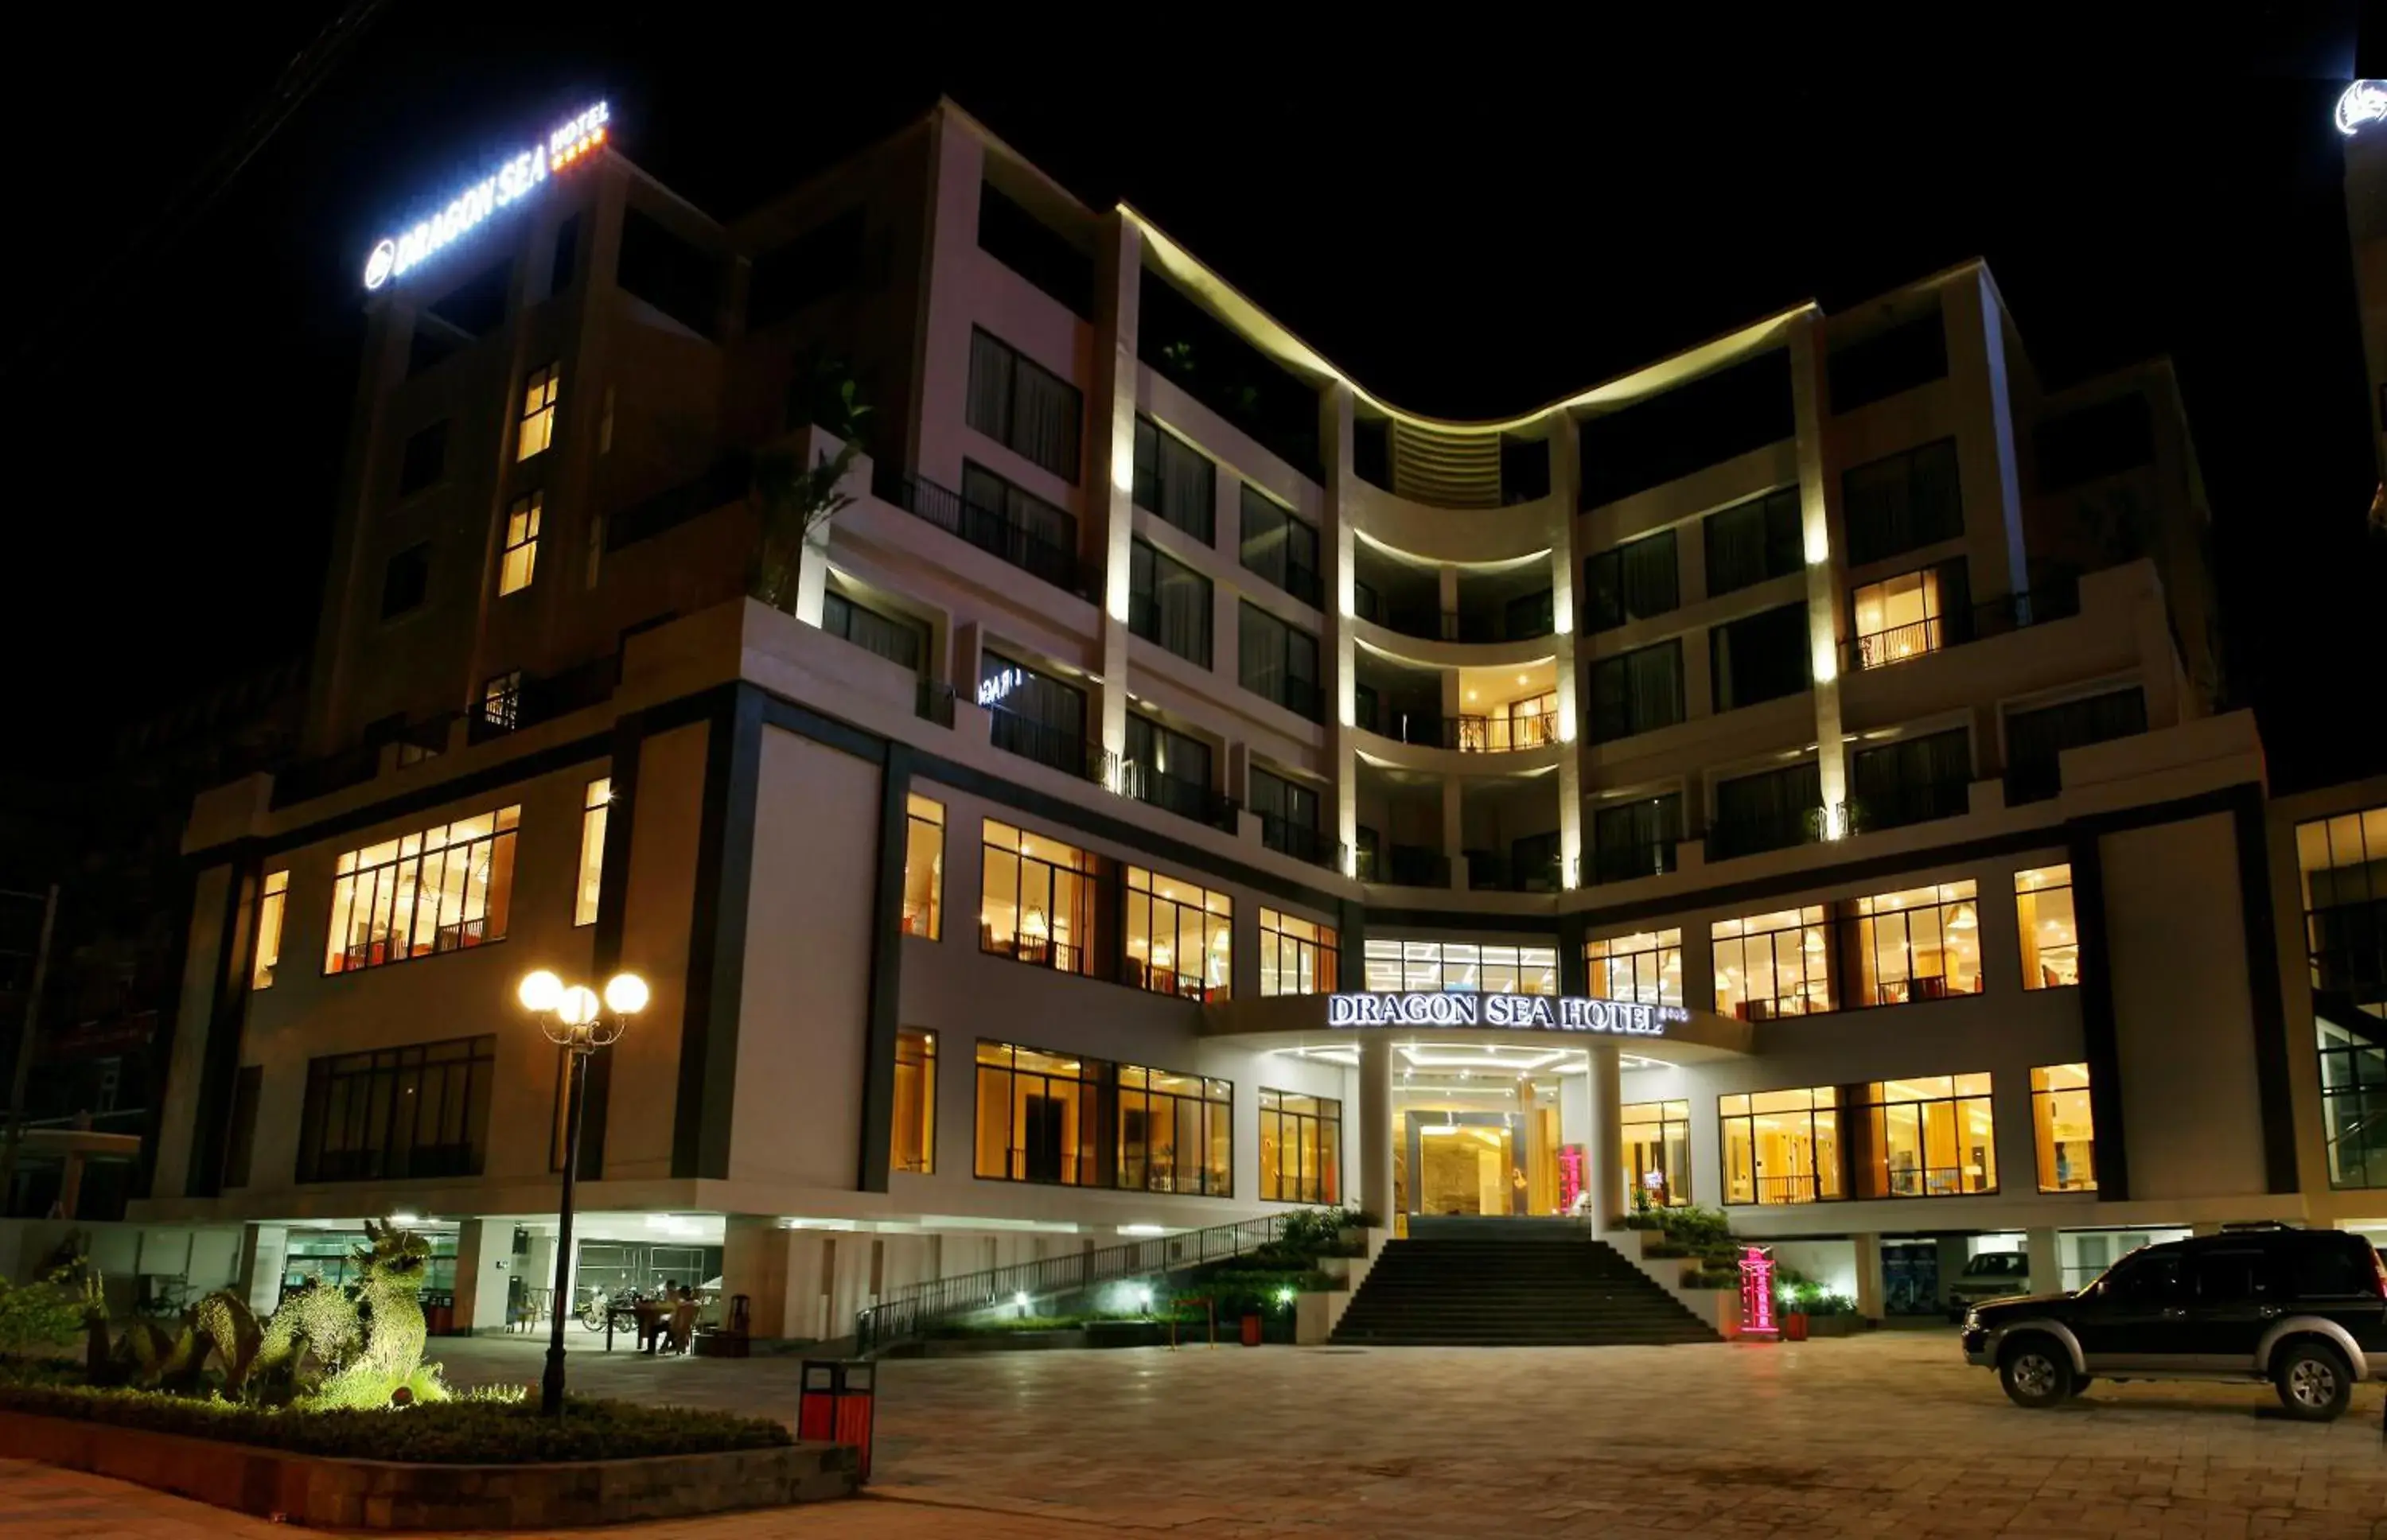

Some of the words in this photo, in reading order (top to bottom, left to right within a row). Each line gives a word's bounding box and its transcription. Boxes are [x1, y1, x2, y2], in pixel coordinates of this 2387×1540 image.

[395, 177, 496, 276] DRAGON
[496, 144, 547, 207] SEA
[551, 101, 609, 154] HOTEL
[1329, 994, 1478, 1025] DRAGON
[1486, 995, 1556, 1028] SEA
[1560, 999, 1664, 1034] HOTEL
